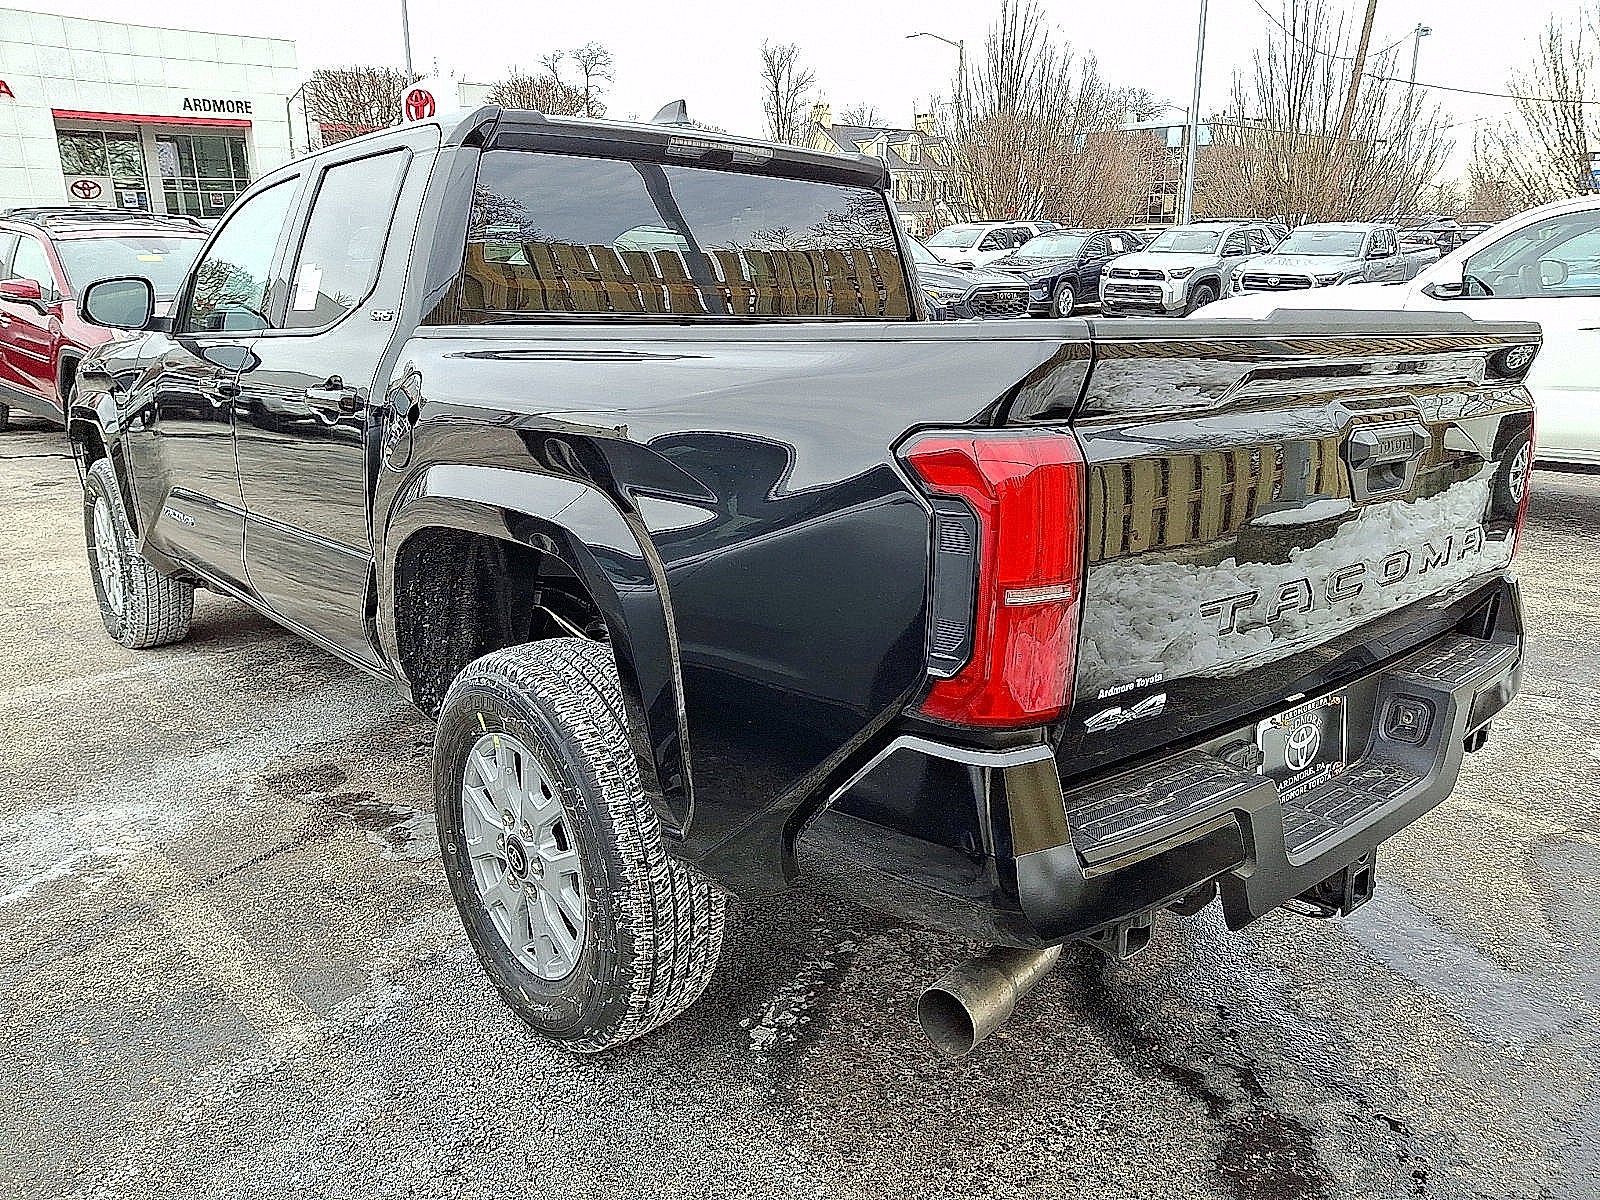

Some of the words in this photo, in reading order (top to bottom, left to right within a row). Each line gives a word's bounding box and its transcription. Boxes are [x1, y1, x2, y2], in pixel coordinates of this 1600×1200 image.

[182, 97, 253, 115] ARDMORE
[996, 292, 1018, 300] TOYOTA
[1199, 524, 1486, 637] TACOMA
[1097, 682, 1135, 700] Ardmore
[1135, 672, 1163, 688] Toyota
[1316, 761, 1326, 772] PA
[1308, 772, 1332, 791] TOYOTA
